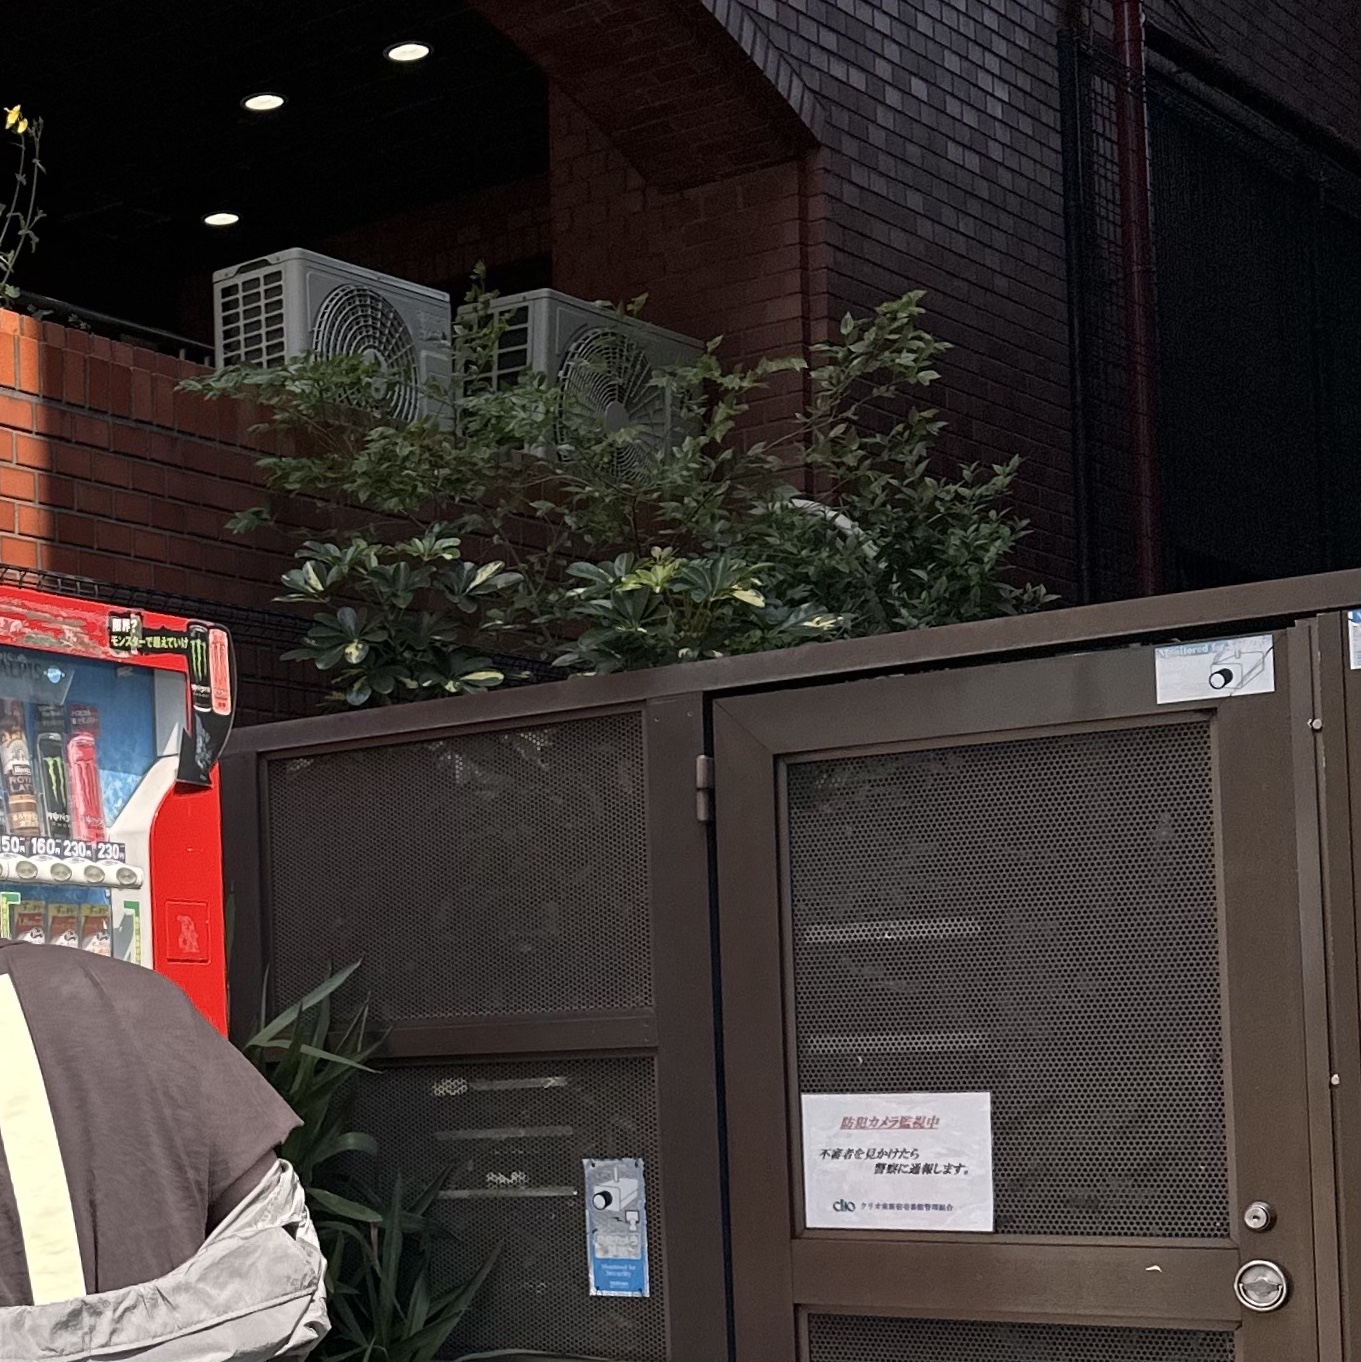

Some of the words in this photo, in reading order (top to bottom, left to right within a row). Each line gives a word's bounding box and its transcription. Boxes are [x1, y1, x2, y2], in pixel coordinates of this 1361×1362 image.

[840, 1115, 940, 1130] 防犯カメラ監視中
[818, 1148, 920, 1160] 不審者を見かけたら
[874, 1163, 969, 1175] 警察に通報します。
